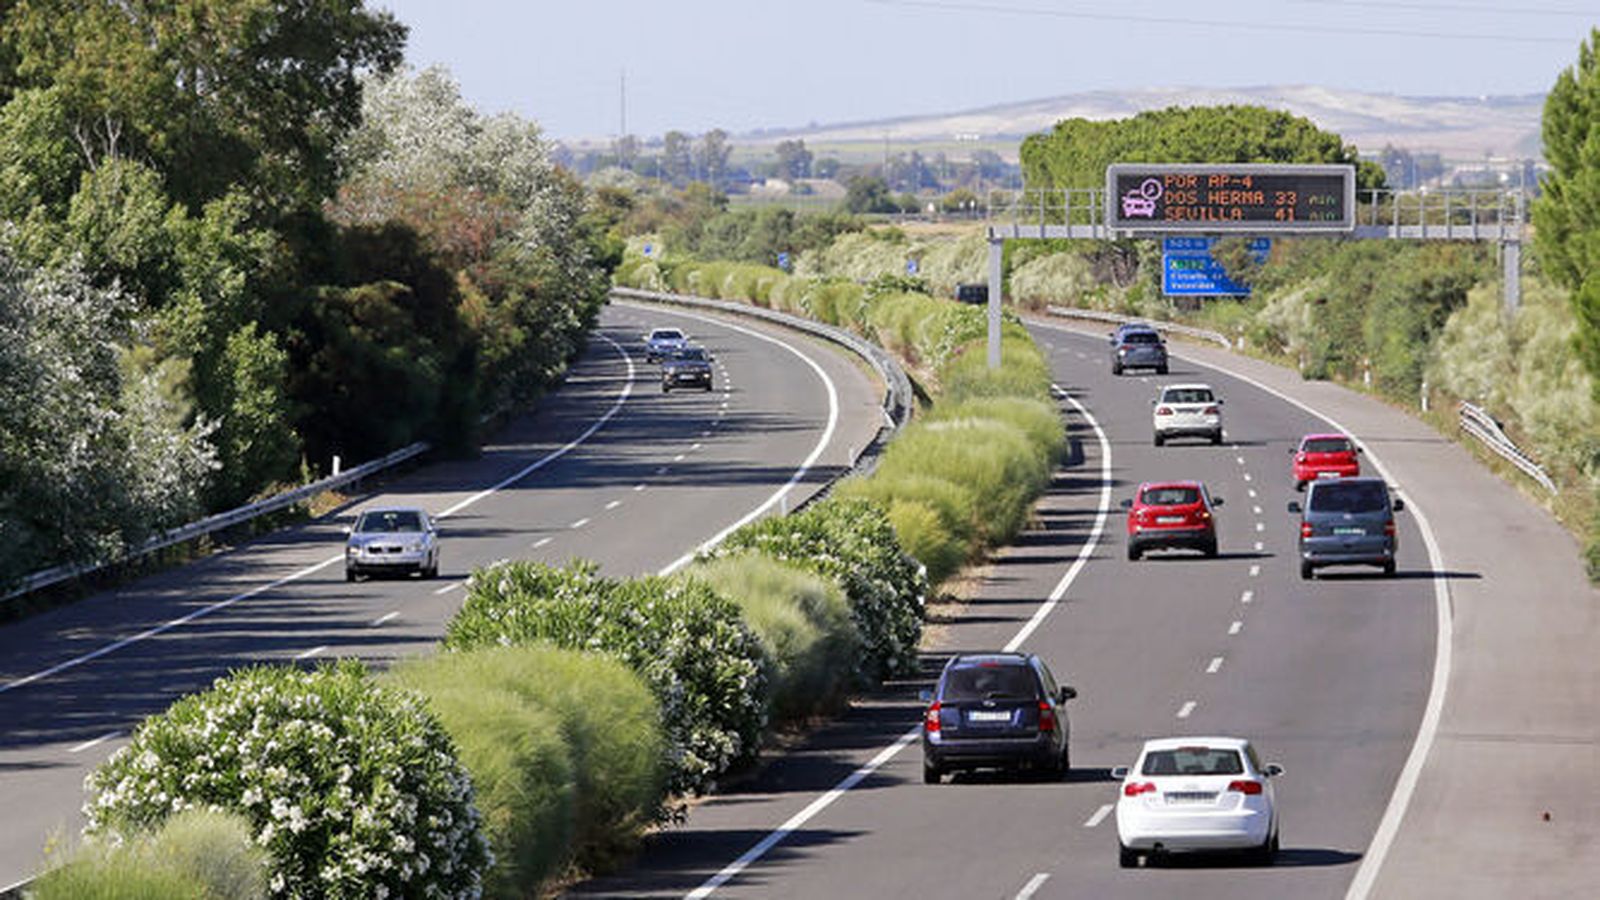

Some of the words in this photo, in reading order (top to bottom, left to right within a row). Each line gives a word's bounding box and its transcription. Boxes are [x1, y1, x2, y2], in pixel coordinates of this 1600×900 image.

[1164, 174, 1198, 188] POR
[1208, 174, 1253, 188] AP-4
[1164, 191, 1198, 205] DOS
[1208, 191, 1264, 205] HERMA
[1275, 191, 1296, 205] 33
[1164, 207, 1242, 222] SEVILLA
[1274, 207, 1295, 222] 41
